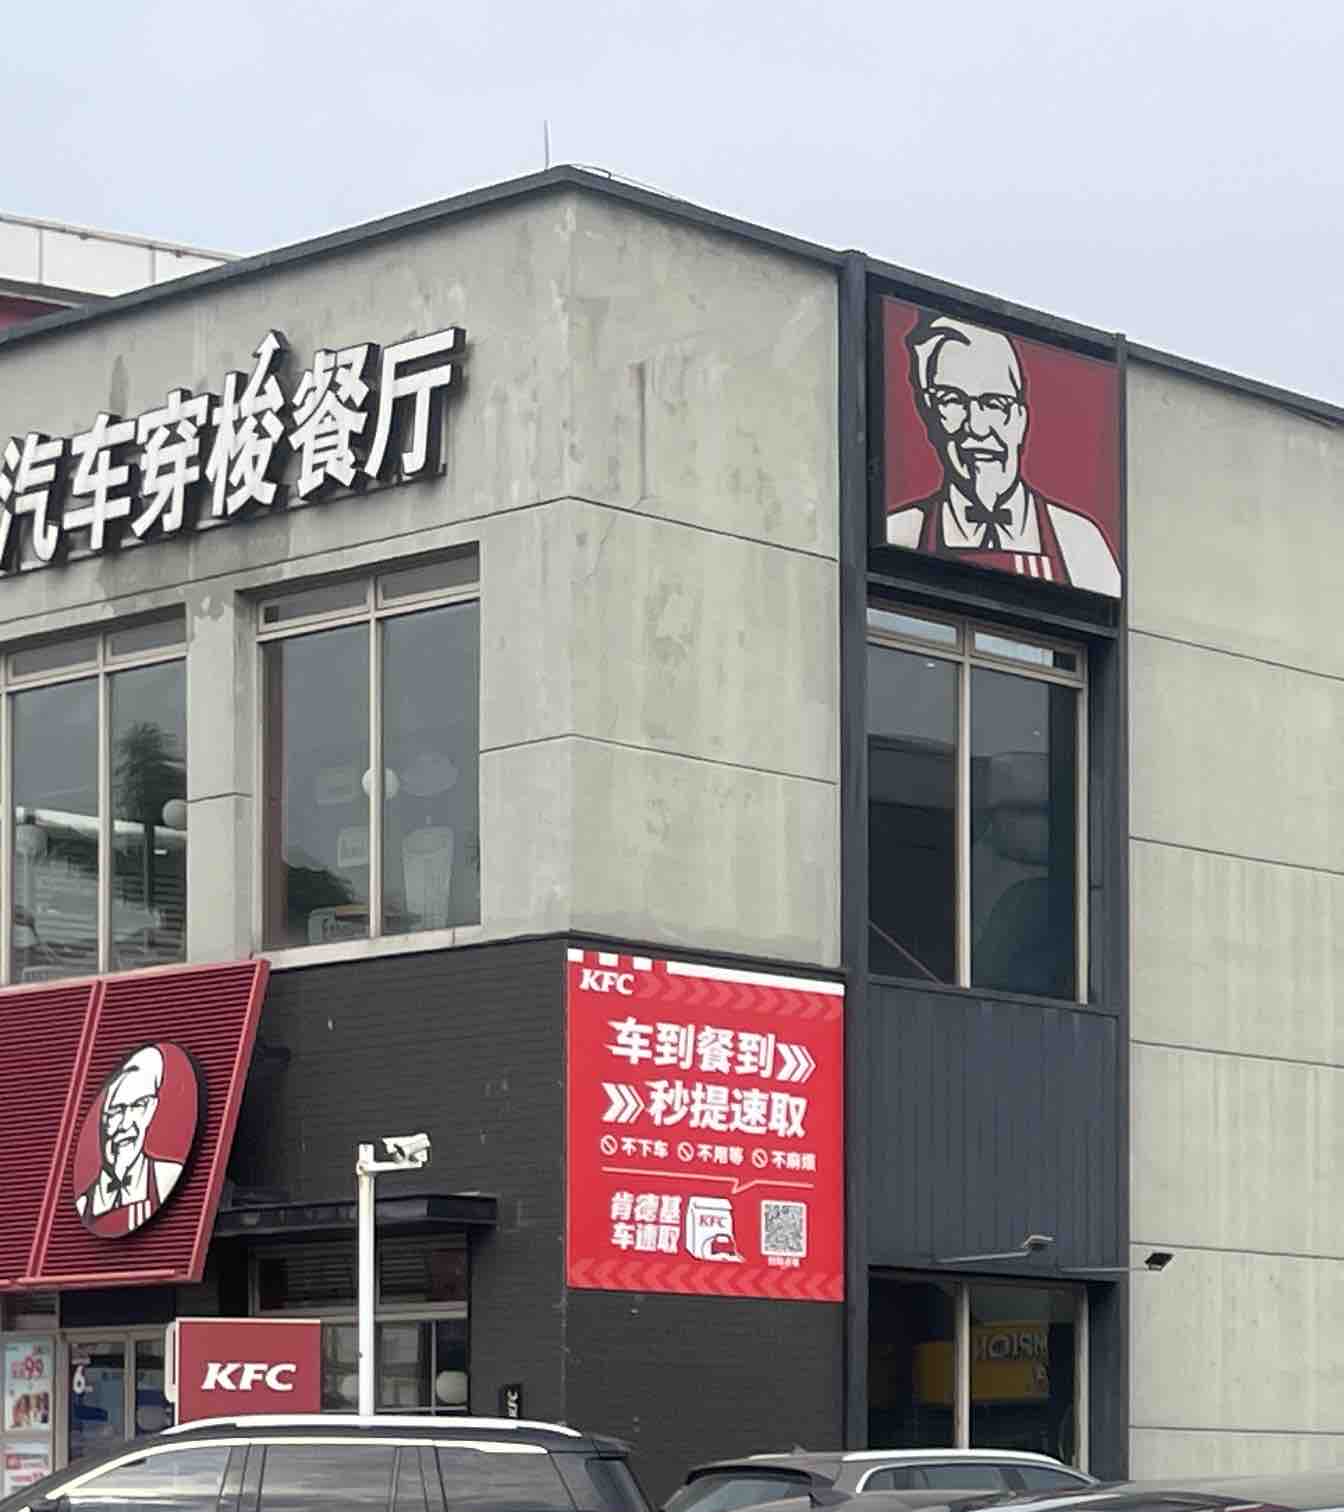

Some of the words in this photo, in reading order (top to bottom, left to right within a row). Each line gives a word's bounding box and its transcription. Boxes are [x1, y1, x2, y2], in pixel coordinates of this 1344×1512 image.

[0, 326, 463, 563] 汽车穿梭餐厅
[579, 968, 636, 996] KFC
[603, 1015, 777, 1079] 车到餐到
[645, 1079, 808, 1138] 秒提速取
[621, 1136, 669, 1159] 不下车
[610, 1190, 683, 1225] 肯德基
[700, 1214, 726, 1229] KFC
[200, 1361, 297, 1392] KFC
